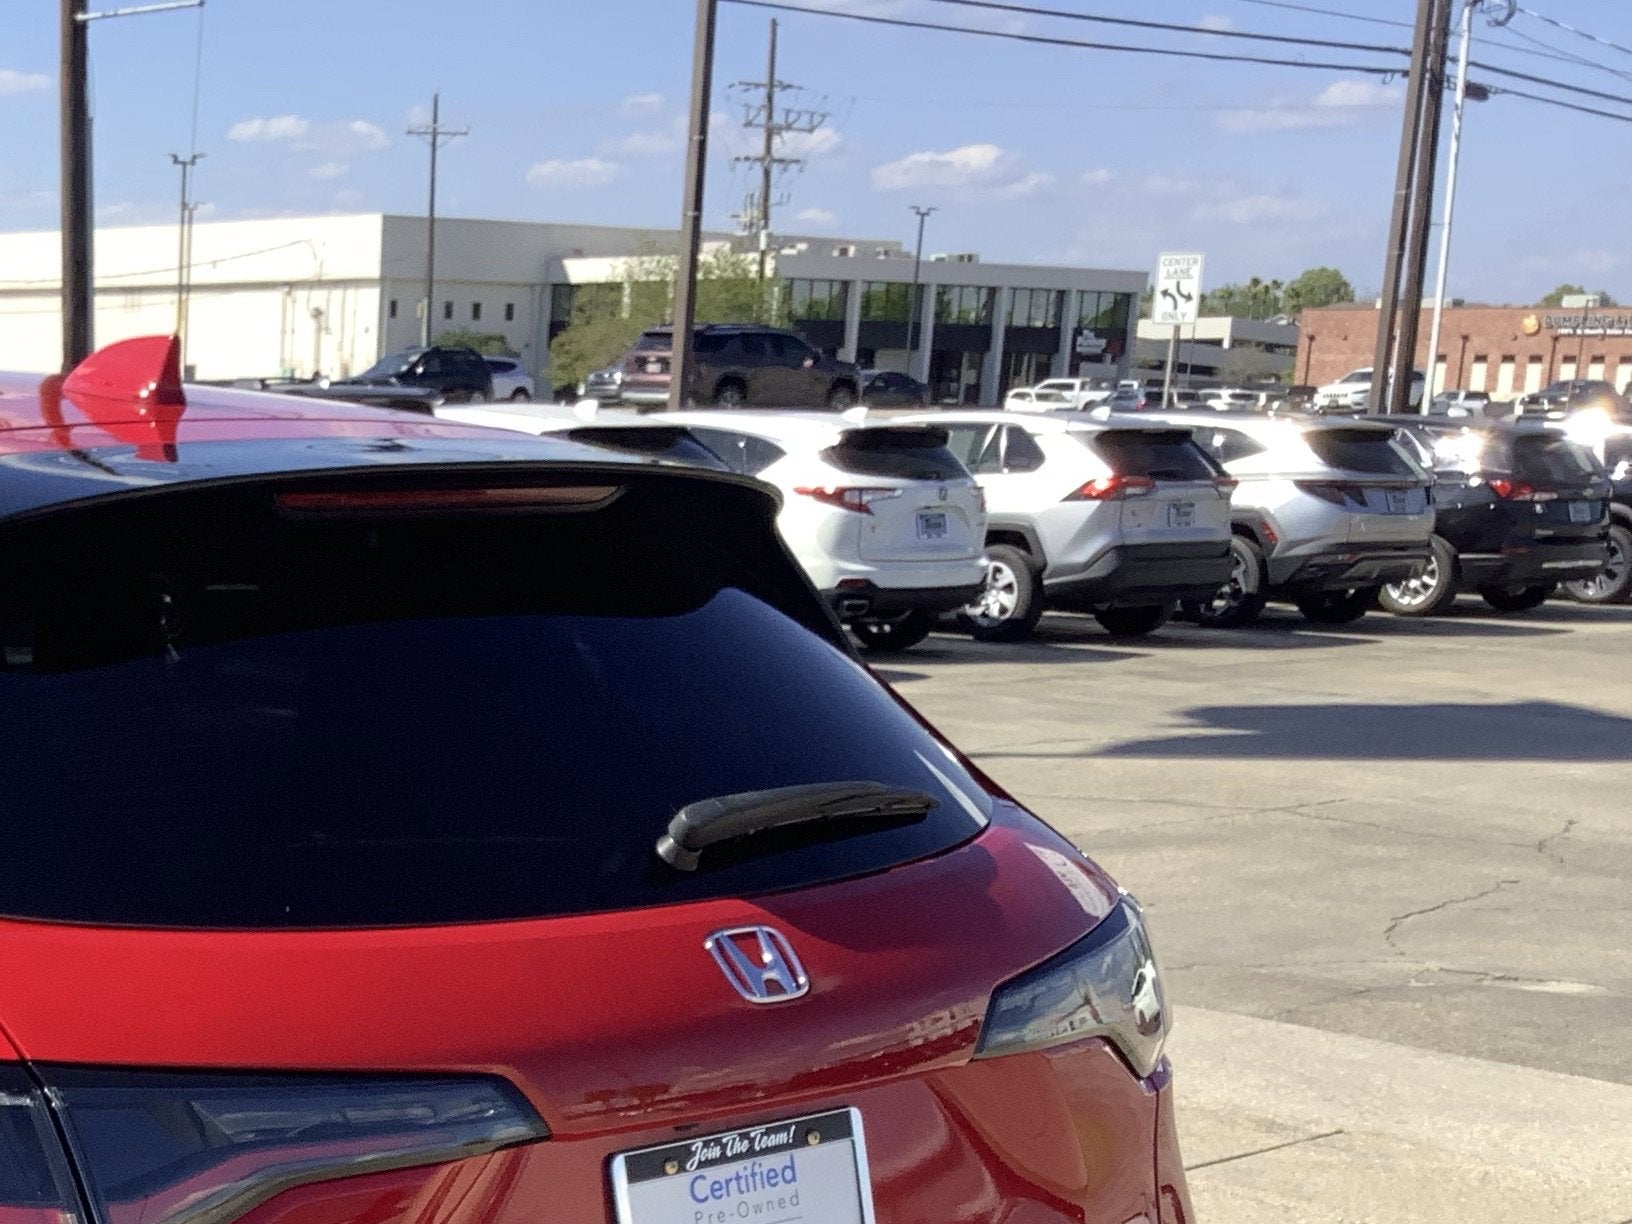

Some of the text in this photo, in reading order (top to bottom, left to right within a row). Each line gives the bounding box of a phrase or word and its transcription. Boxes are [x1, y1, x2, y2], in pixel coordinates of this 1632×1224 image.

[1163, 257, 1199, 267] CENTER
[1167, 267, 1192, 277] LANE
[1162, 311, 1187, 321] ONLY
[686, 1125, 797, 1171] Join The Team!
[690, 1153, 797, 1204] Certified
